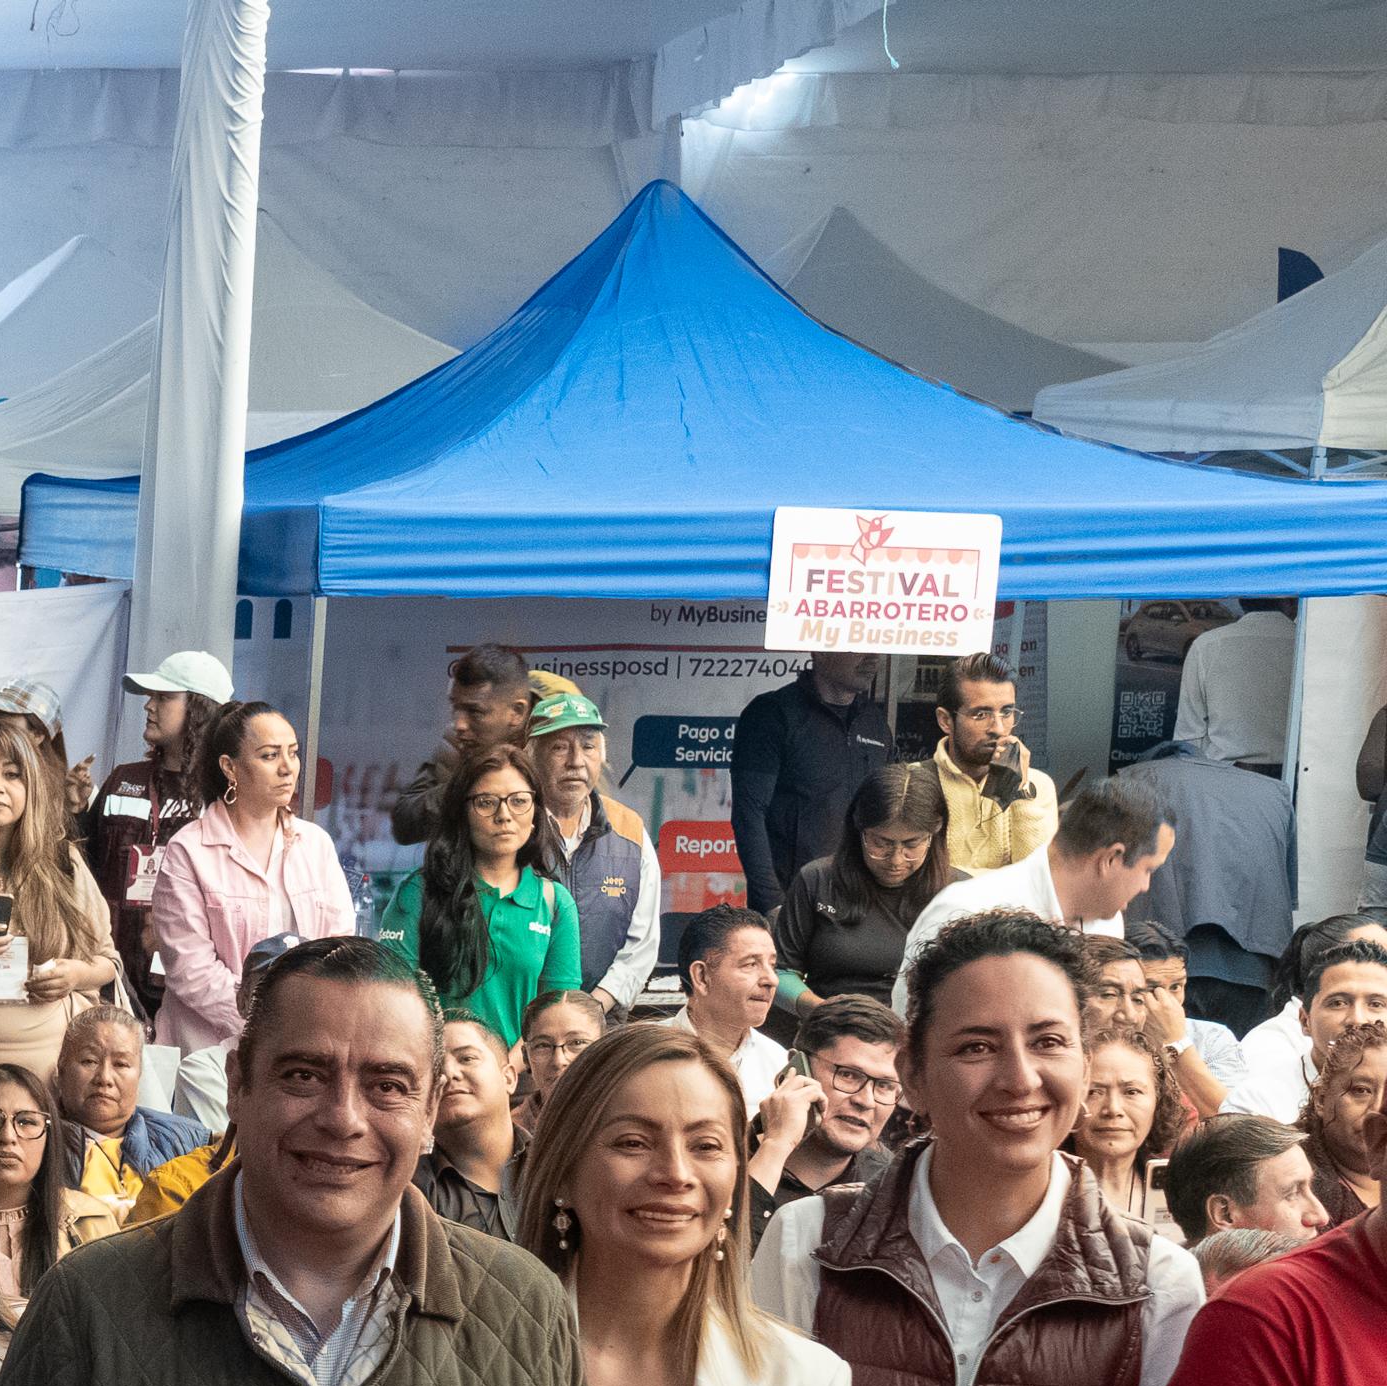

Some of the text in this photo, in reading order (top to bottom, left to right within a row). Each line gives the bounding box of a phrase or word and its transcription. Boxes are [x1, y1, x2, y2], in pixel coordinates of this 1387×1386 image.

[805, 568, 960, 598] FESTIVAL
[651, 603, 766, 626] by MyBusine
[794, 598, 969, 622] ABARROTERO
[798, 619, 959, 648] My Business
[678, 724, 720, 743] Pago
[603, 876, 625, 886] Jeep
